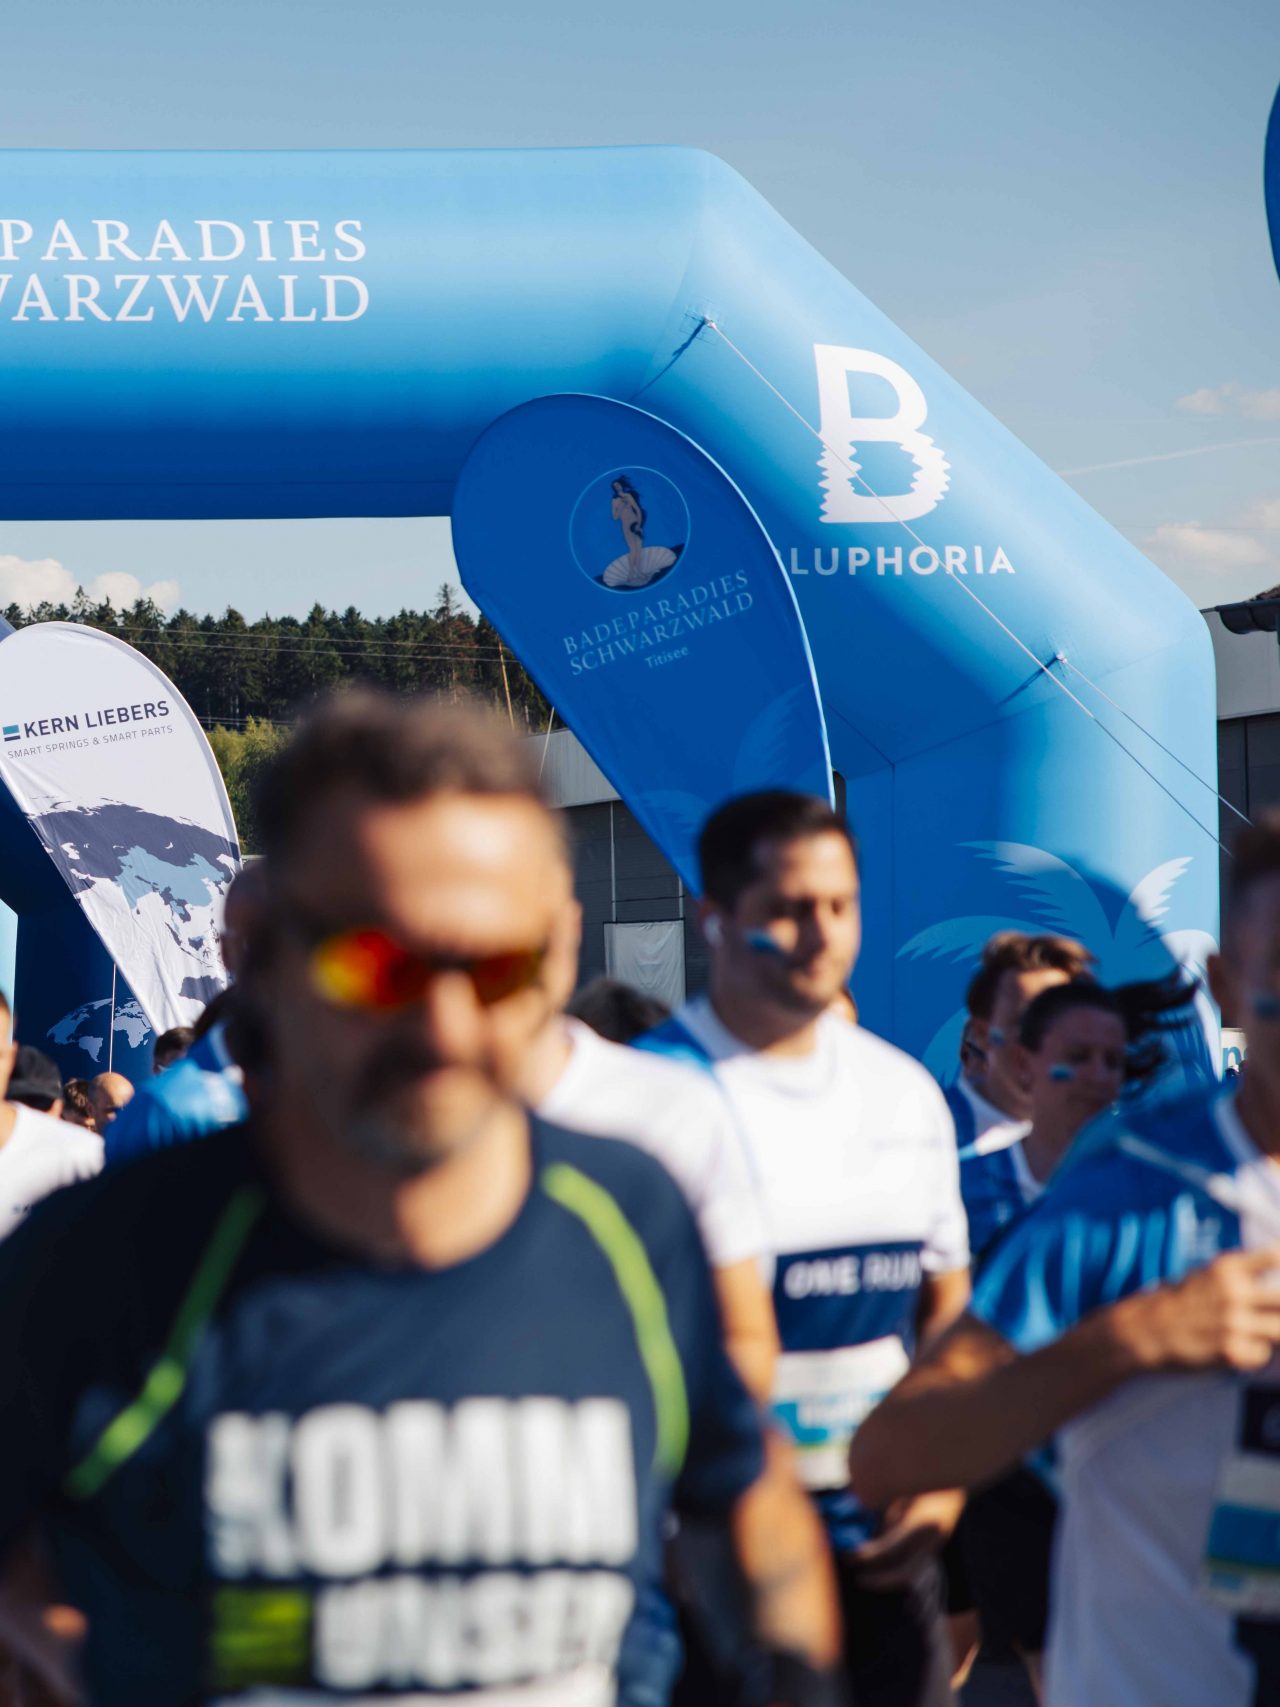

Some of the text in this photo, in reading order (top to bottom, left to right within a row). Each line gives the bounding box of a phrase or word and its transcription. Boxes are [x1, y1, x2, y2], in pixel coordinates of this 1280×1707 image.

[777, 544, 1016, 577] LUPHORIA
[563, 569, 750, 655] BADEPARADIES
[570, 591, 754, 676] SCHWARZWALD
[644, 644, 690, 669] Titisee
[24, 700, 170, 739] KERN LIEBERS
[7, 746, 41, 759] SMART
[45, 738, 89, 753] SPRINGS
[102, 730, 138, 744] SMART
[140, 724, 174, 738] PARTS
[783, 1254, 861, 1299] ONE
[206, 1396, 639, 1579] KOMM
